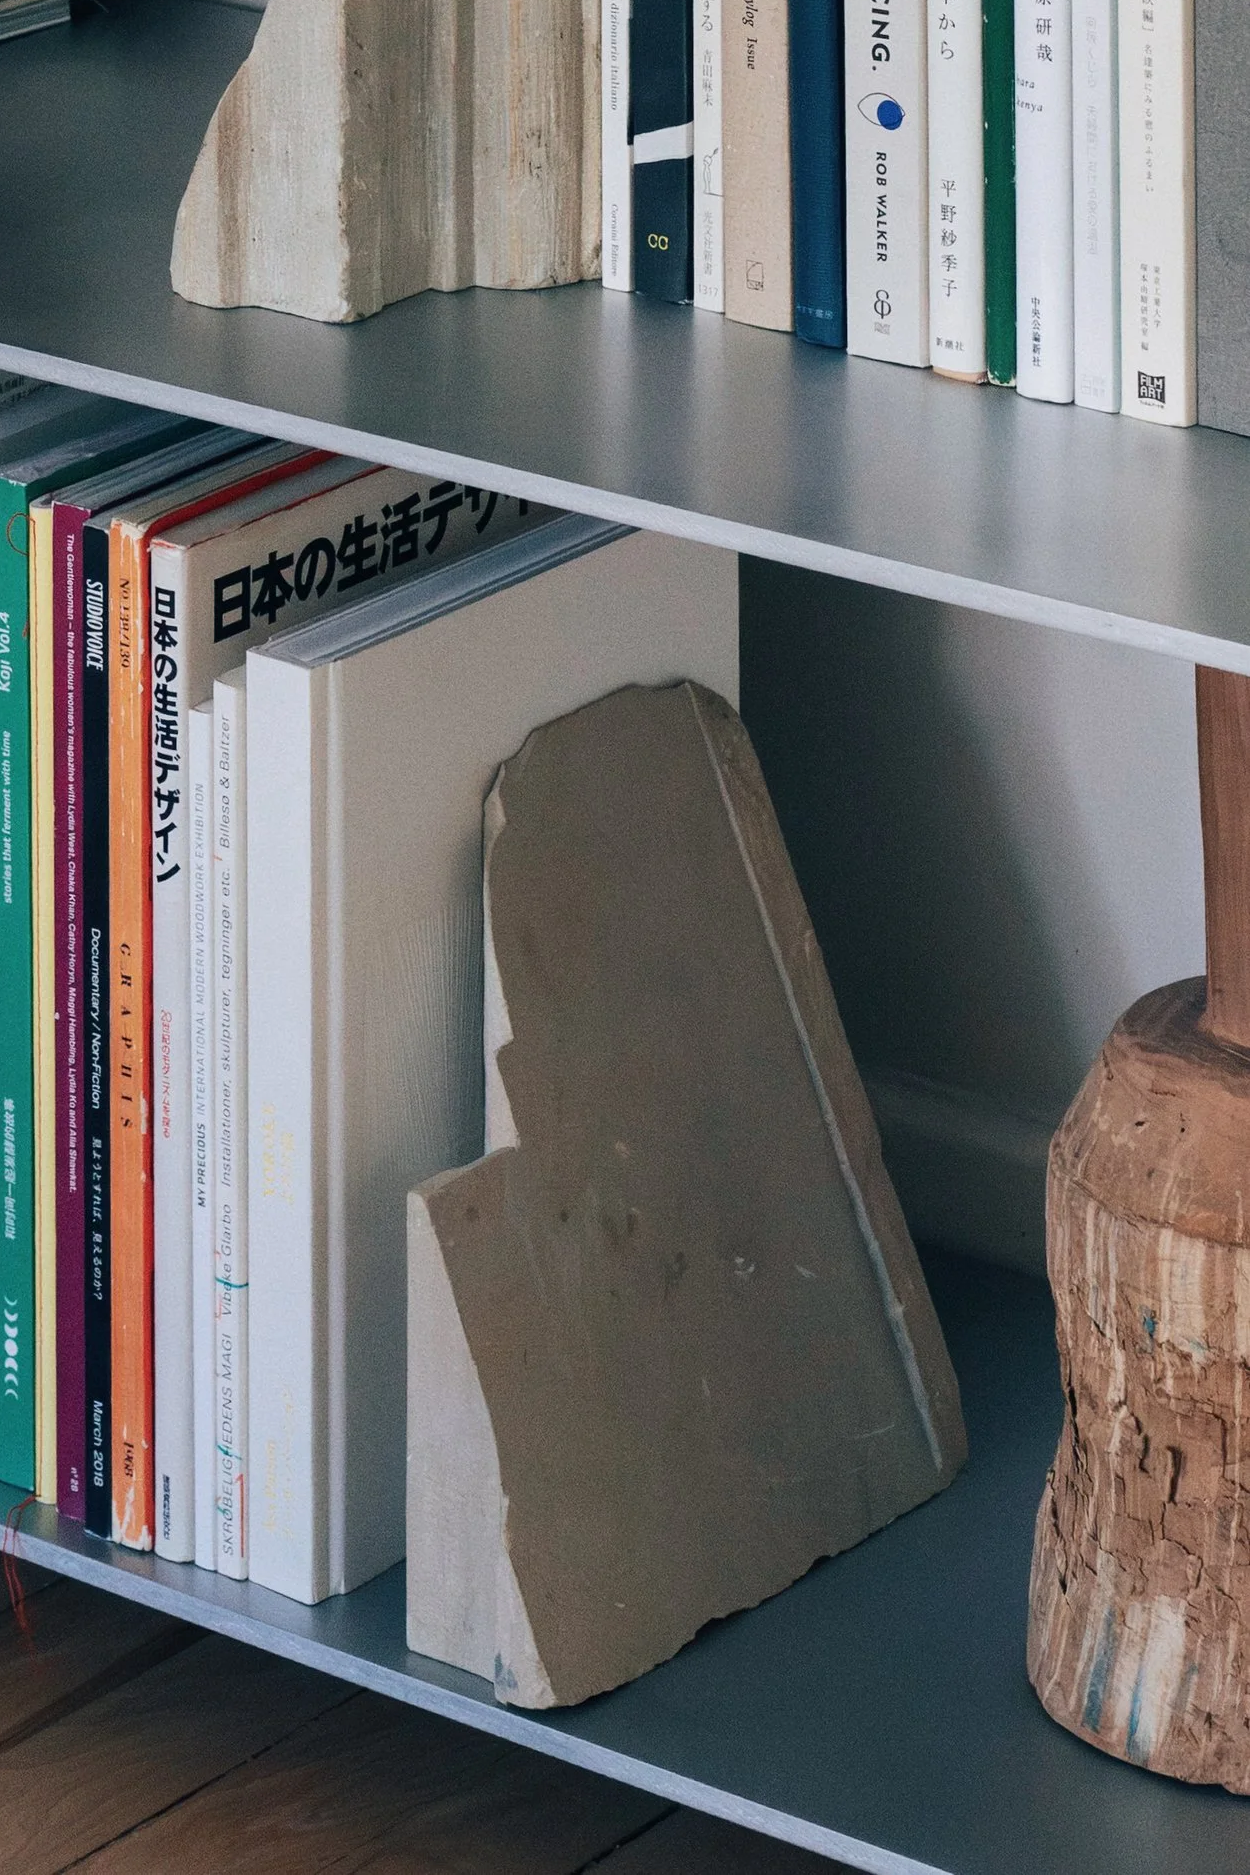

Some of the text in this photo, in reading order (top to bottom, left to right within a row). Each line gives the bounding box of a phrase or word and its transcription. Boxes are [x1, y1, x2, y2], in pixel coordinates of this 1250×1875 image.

[611, 2, 621, 62] dizionario
[747, 37, 757, 70] Issue
[611, 66, 620, 110] italiano
[611, 204, 620, 276] Corraini Editore
[876, 151, 888, 262] ROB WALKER
[1140, 374, 1163, 390] FILM
[1140, 386, 1162, 401] ART
[119, 578, 131, 598] No
[153, 586, 182, 883] 日本の生活デザイン
[2, 730, 13, 904] stories that ferment with time
[66, 533, 77, 1193] The Gentlewoman the fabulous women's Shawkat.
[89, 928, 103, 1108] Documentary Non-Fiction
[194, 783, 206, 1208] MY PRECIOUS INTERNATIONAL MODERN WOODWORK EXHIBITION
[219, 713, 234, 1556] SKRØBELIGHEDENS MAGI Vibeke Glarbo Installationer, skulpturer, tegninger etc. Billesø & Baltzer
[93, 1400, 104, 1487] March 2018
[123, 1441, 135, 1478] 1968
